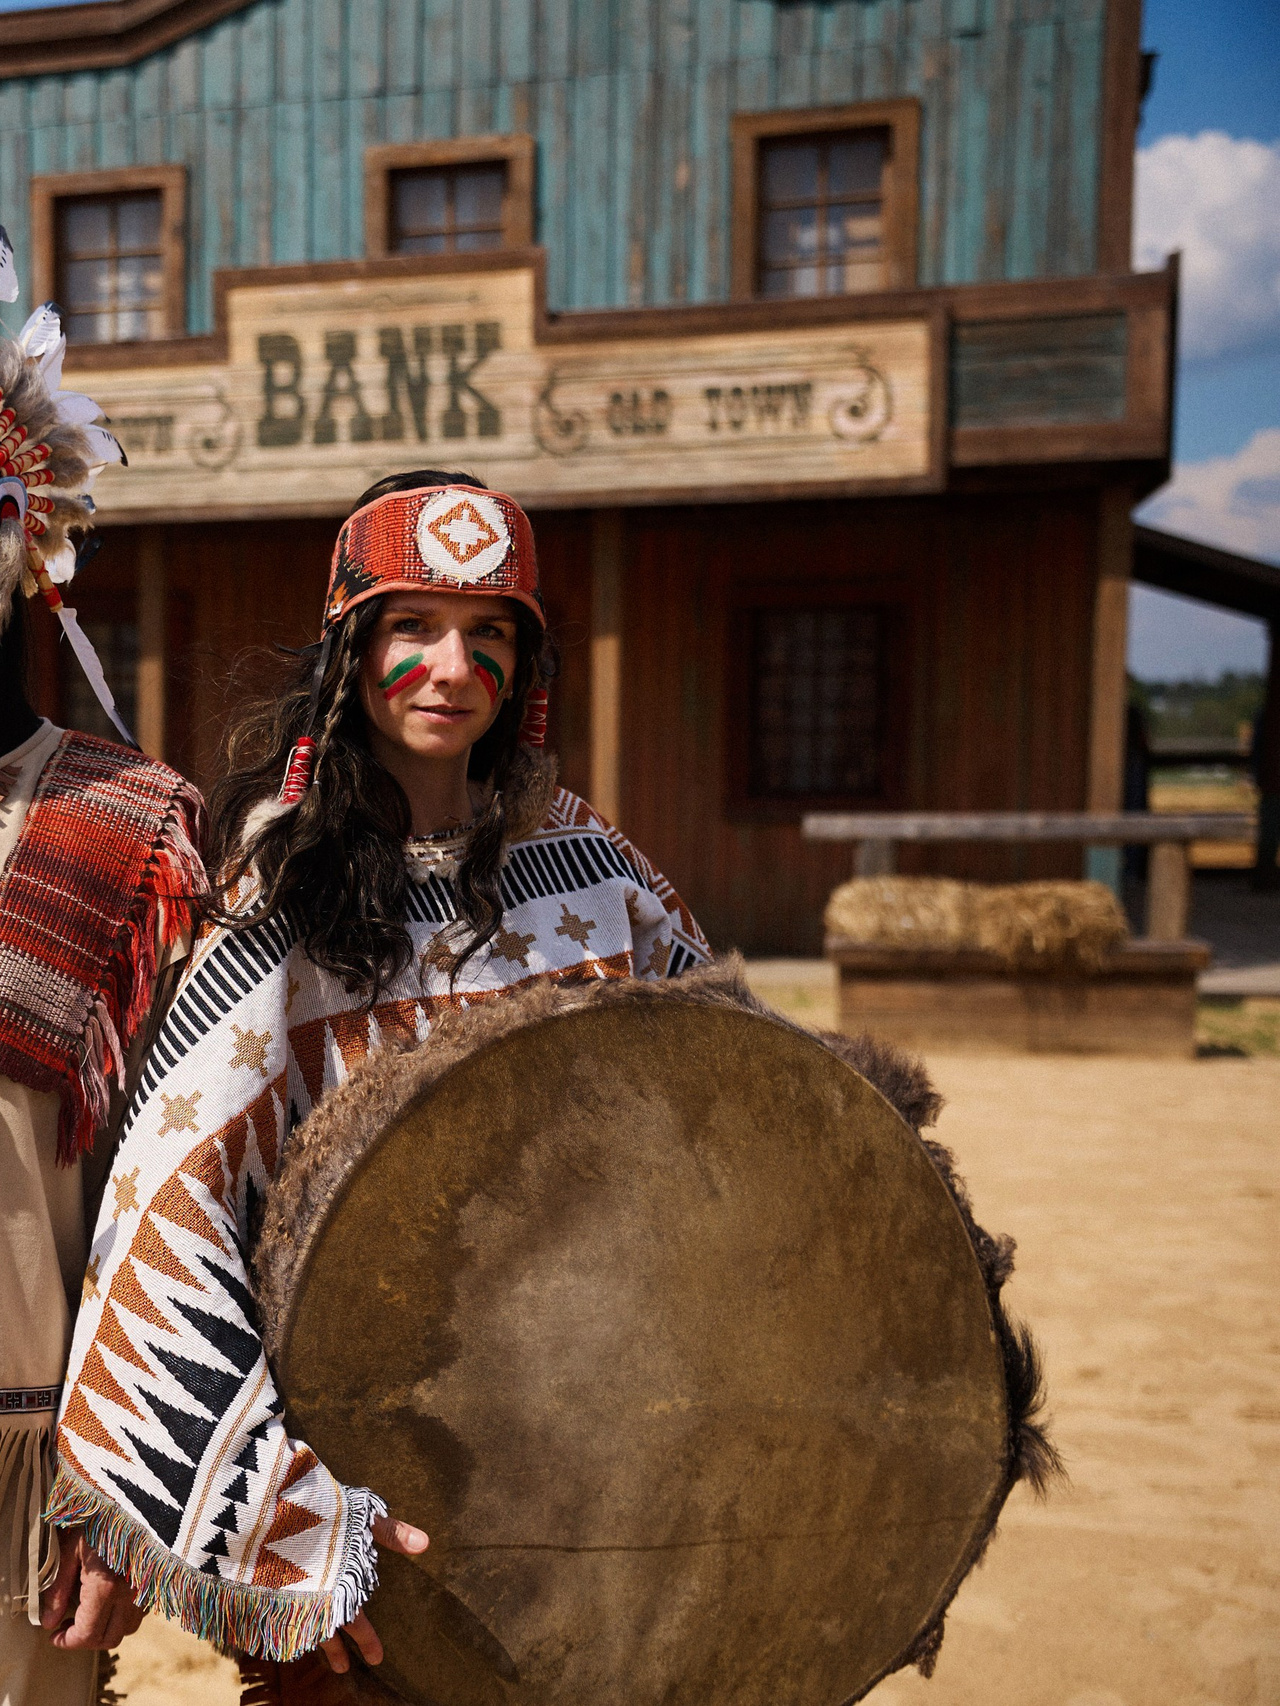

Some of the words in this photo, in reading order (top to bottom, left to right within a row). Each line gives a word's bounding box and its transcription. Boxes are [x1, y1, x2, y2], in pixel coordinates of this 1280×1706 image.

[257, 322, 501, 447] BANK
[606, 388, 669, 434] OLD
[704, 383, 812, 431] TOWN
